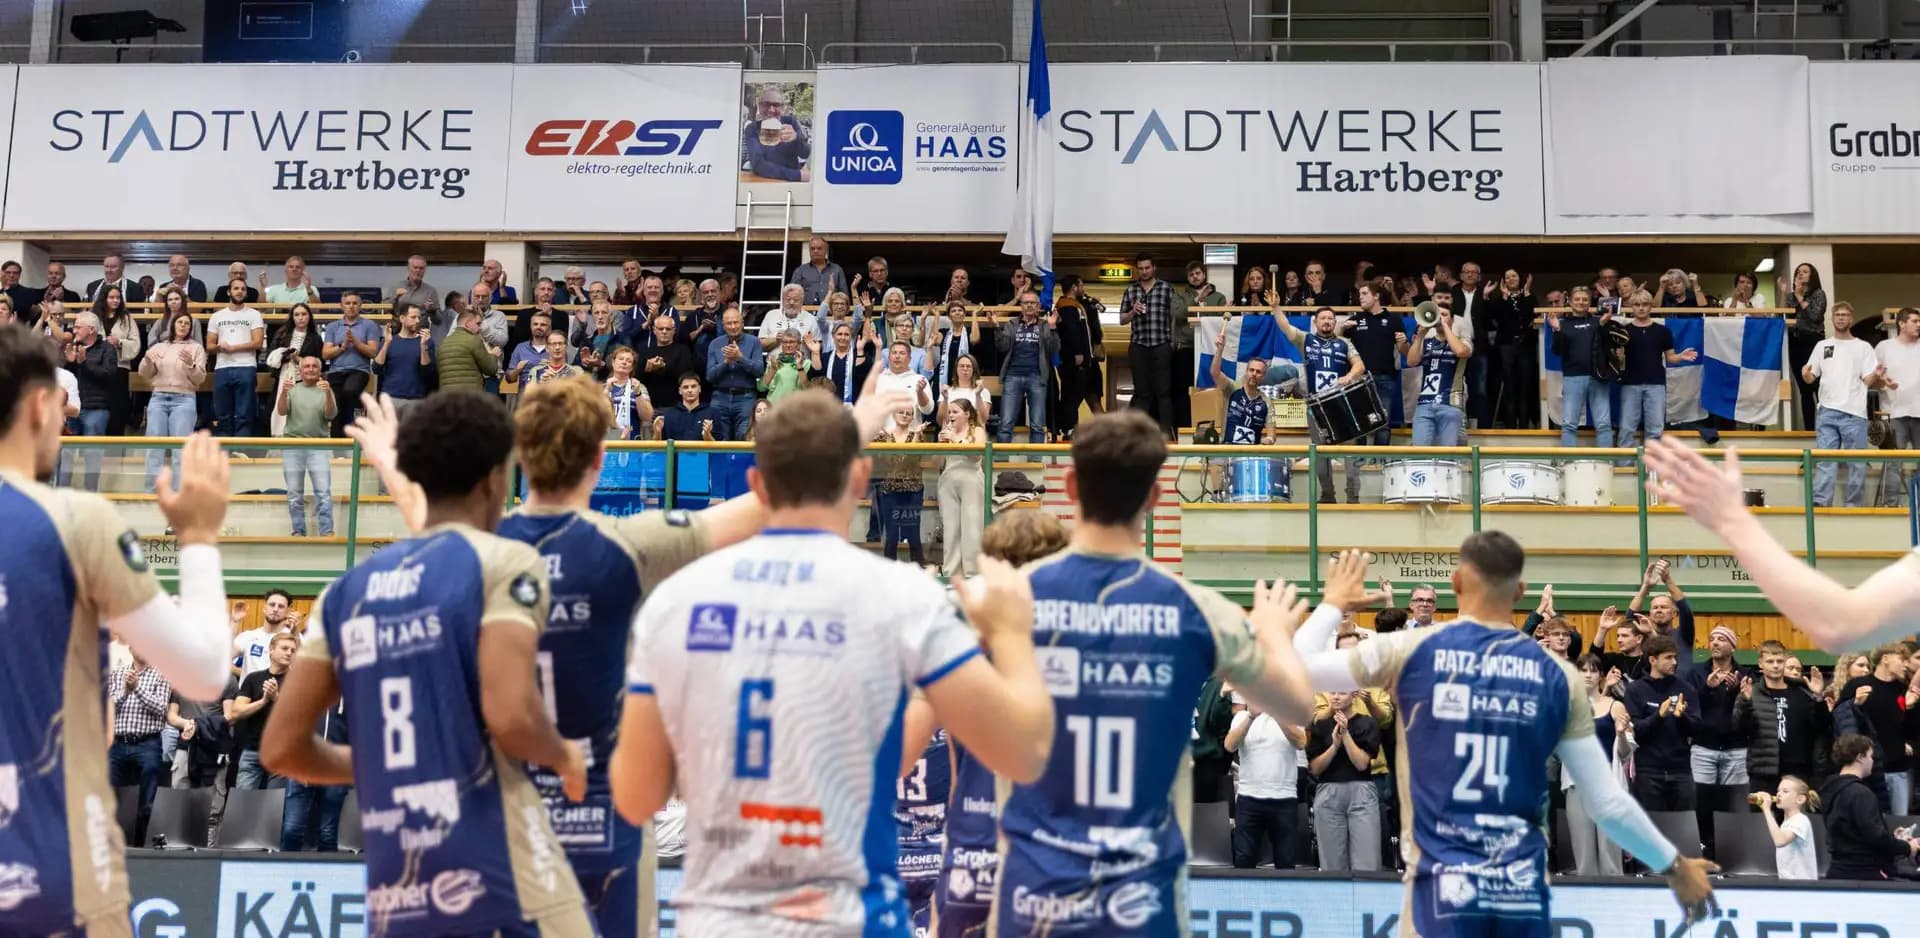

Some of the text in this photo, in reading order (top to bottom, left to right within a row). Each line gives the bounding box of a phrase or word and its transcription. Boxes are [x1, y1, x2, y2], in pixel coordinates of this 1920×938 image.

[49, 109, 473, 163] STADTWERKE
[525, 120, 723, 156] ERST
[916, 122, 1006, 135] GeneralAgentur
[1058, 108, 1503, 164] STADTWERKE
[916, 136, 1007, 158] HAAS
[566, 162, 712, 177] elektro-regeltechnik.at
[832, 156, 897, 172] UNIQA
[1831, 163, 1876, 173] Gruppe
[272, 160, 470, 199] Hartberg
[1296, 161, 1503, 201] Hartberg
[1330, 551, 1459, 565] SDTWERKE
[1400, 566, 1450, 578] Hartber
[550, 602, 592, 622] AS
[379, 614, 443, 648] HAAS
[744, 618, 847, 645] HAAS
[1083, 662, 1174, 686] HAAS
[1472, 694, 1537, 717] HAAS
[380, 676, 417, 771] 8
[734, 678, 775, 779] 6
[1066, 715, 1136, 809] 10
[1452, 732, 1510, 804] 24
[544, 806, 606, 823] CHER
[234, 881, 366, 938] KÄF
